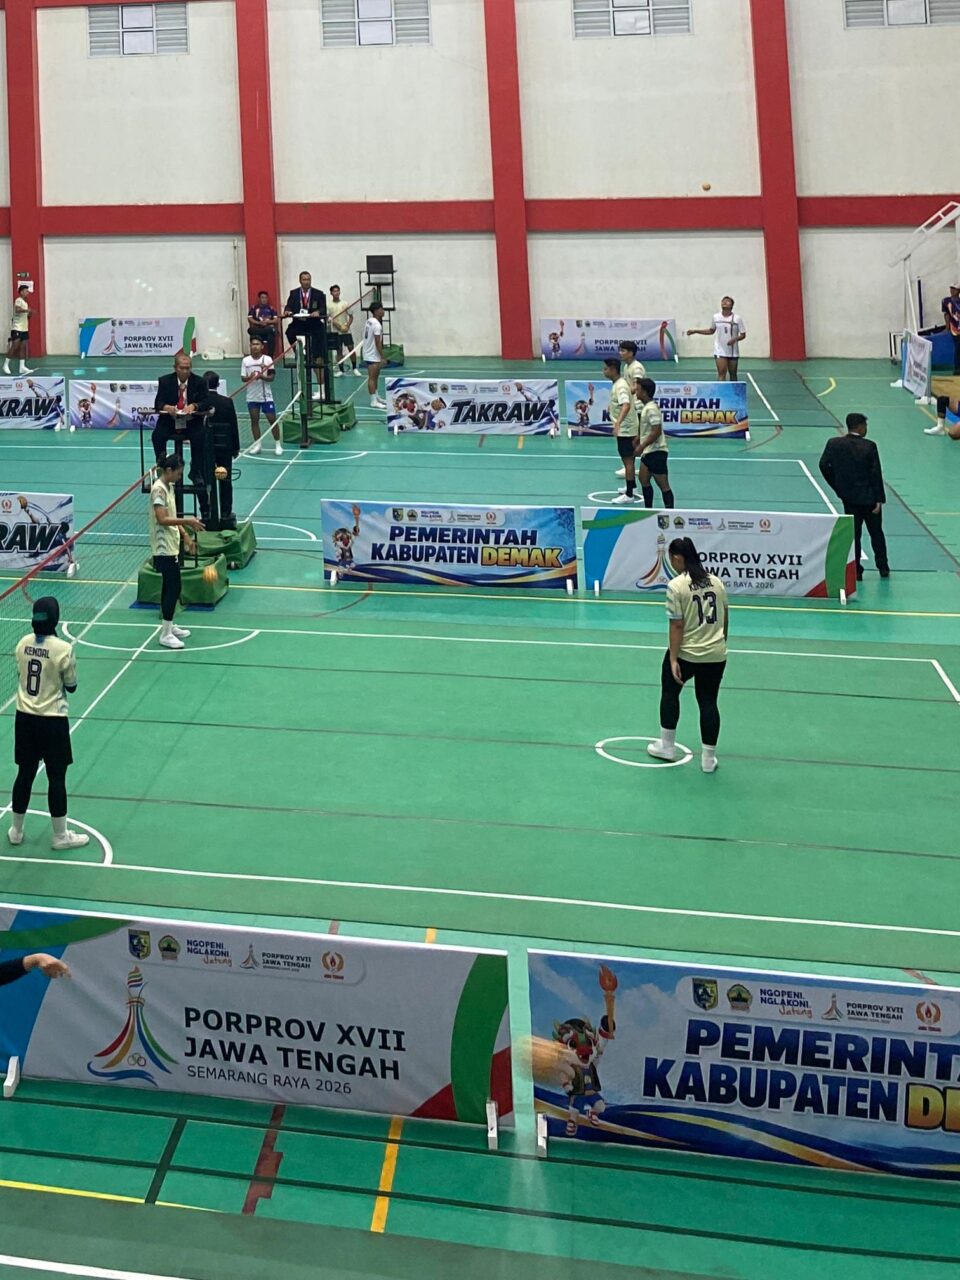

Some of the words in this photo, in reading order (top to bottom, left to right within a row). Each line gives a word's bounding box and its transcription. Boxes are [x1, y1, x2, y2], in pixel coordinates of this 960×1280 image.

[449, 399, 546, 424] TAKRAW
[680, 410, 738, 424] DEMAK
[390, 525, 537, 546] PEMERINTAH
[371, 543, 479, 564] KABUPATEN
[480, 546, 563, 568] DEMAK
[698, 552, 761, 565] ORPROV
[767, 554, 803, 566] XVII
[736, 567, 800, 580] TENGAH
[755, 581, 774, 589] 2026
[692, 591, 717, 627] 13
[23, 646, 50, 659] KENDAL
[26, 658, 42, 696] 8
[261, 952, 295, 961] PORPROV
[296, 954, 312, 962] XVII
[262, 958, 282, 966] JAWA
[283, 960, 311, 969] TENGAH
[779, 1005, 813, 1019] Jateng
[847, 1002, 884, 1012] PORPROV
[886, 1004, 904, 1014] XVII
[847, 1010, 869, 1018] JAWA
[871, 1011, 903, 1020] TENGAH
[184, 1007, 326, 1042] PORPROV
[336, 1023, 406, 1052] XVII
[184, 1036, 268, 1066] JAWA
[276, 1046, 400, 1080] TENGAH
[685, 1019, 960, 1082] PEMERINT
[187, 1065, 268, 1085] SEMARANG
[273, 1075, 311, 1090] RAYA
[316, 1078, 352, 1094] 2026
[642, 1056, 899, 1122] KABUPATEN
